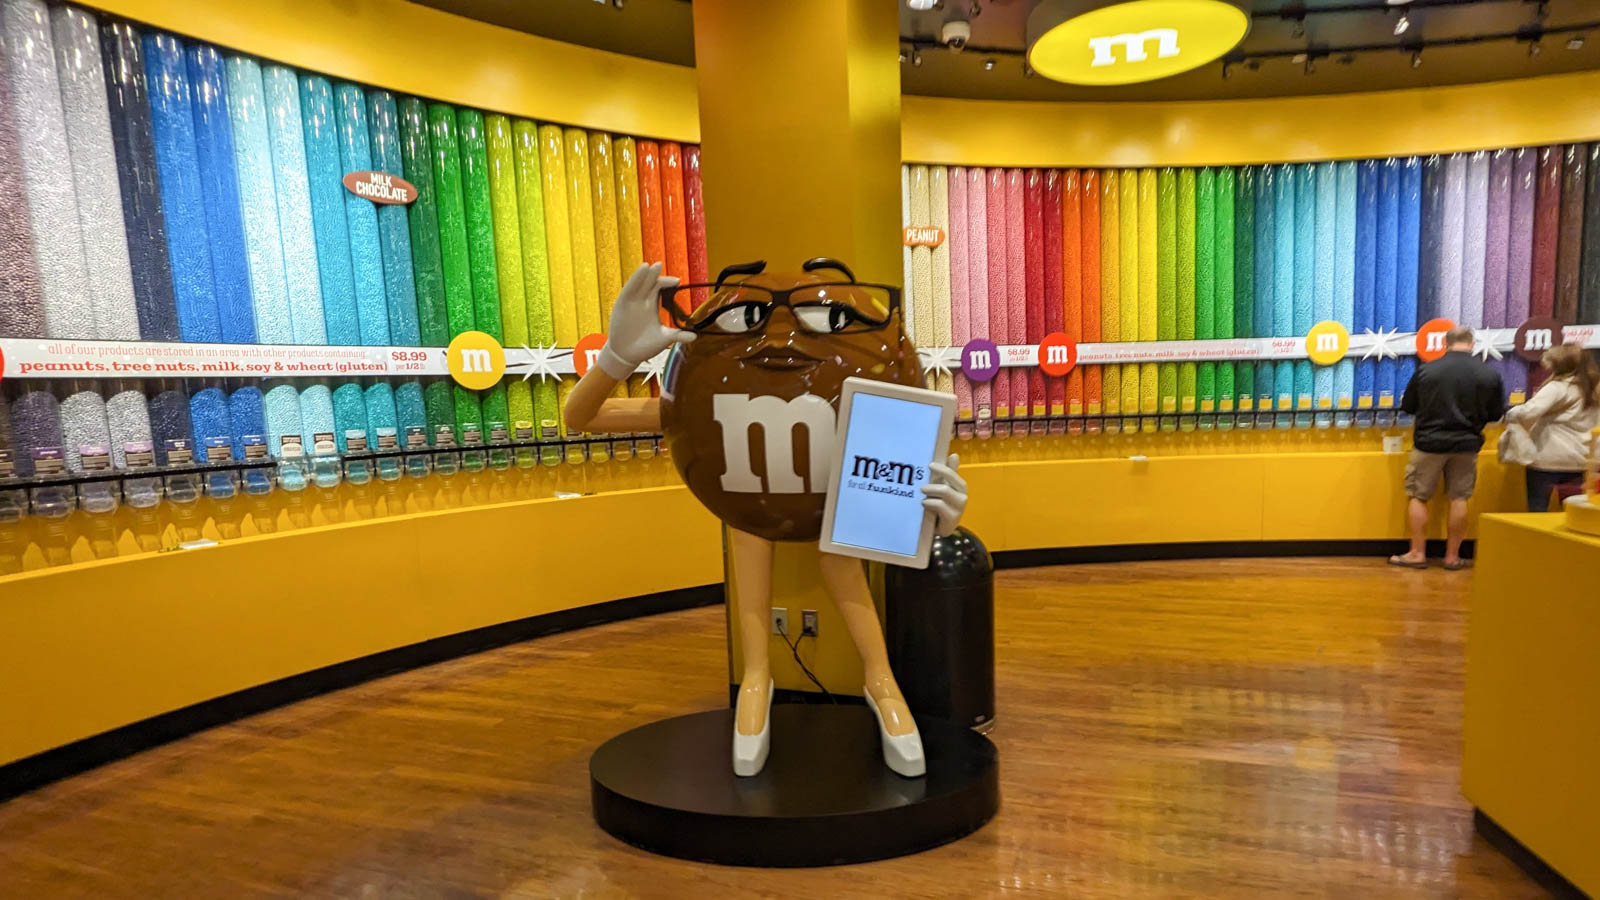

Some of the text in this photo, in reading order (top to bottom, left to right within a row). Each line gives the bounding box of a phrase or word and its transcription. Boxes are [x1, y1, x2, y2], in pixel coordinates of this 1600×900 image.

[1088, 28, 1180, 67] m
[370, 173, 393, 187] MILK
[355, 181, 408, 202] CHOCOLATE
[906, 229, 939, 241] PEANUT
[1316, 333, 1339, 352] m
[1525, 328, 1552, 350] m
[48, 343, 62, 355] all
[65, 343, 76, 355] of
[77, 346, 96, 355] our
[98, 344, 144, 358] products
[146, 348, 162, 356] are
[164, 346, 194, 357] stored
[196, 347, 205, 357] in
[207, 348, 218, 357] an
[219, 349, 240, 358] area
[241, 347, 262, 358] with
[263, 347, 286, 358] other
[288, 348, 324, 360] products
[391, 351, 428, 361] $8.99
[461, 348, 493, 373] m
[969, 350, 992, 370] m
[1047, 345, 1069, 364] m
[19, 361, 388, 374] peanuts, tree nuts, milk, soy & wheat (gluten)
[406, 362, 419, 370] 1/2
[713, 393, 838, 494] m
[867, 483, 915, 498] funkind
